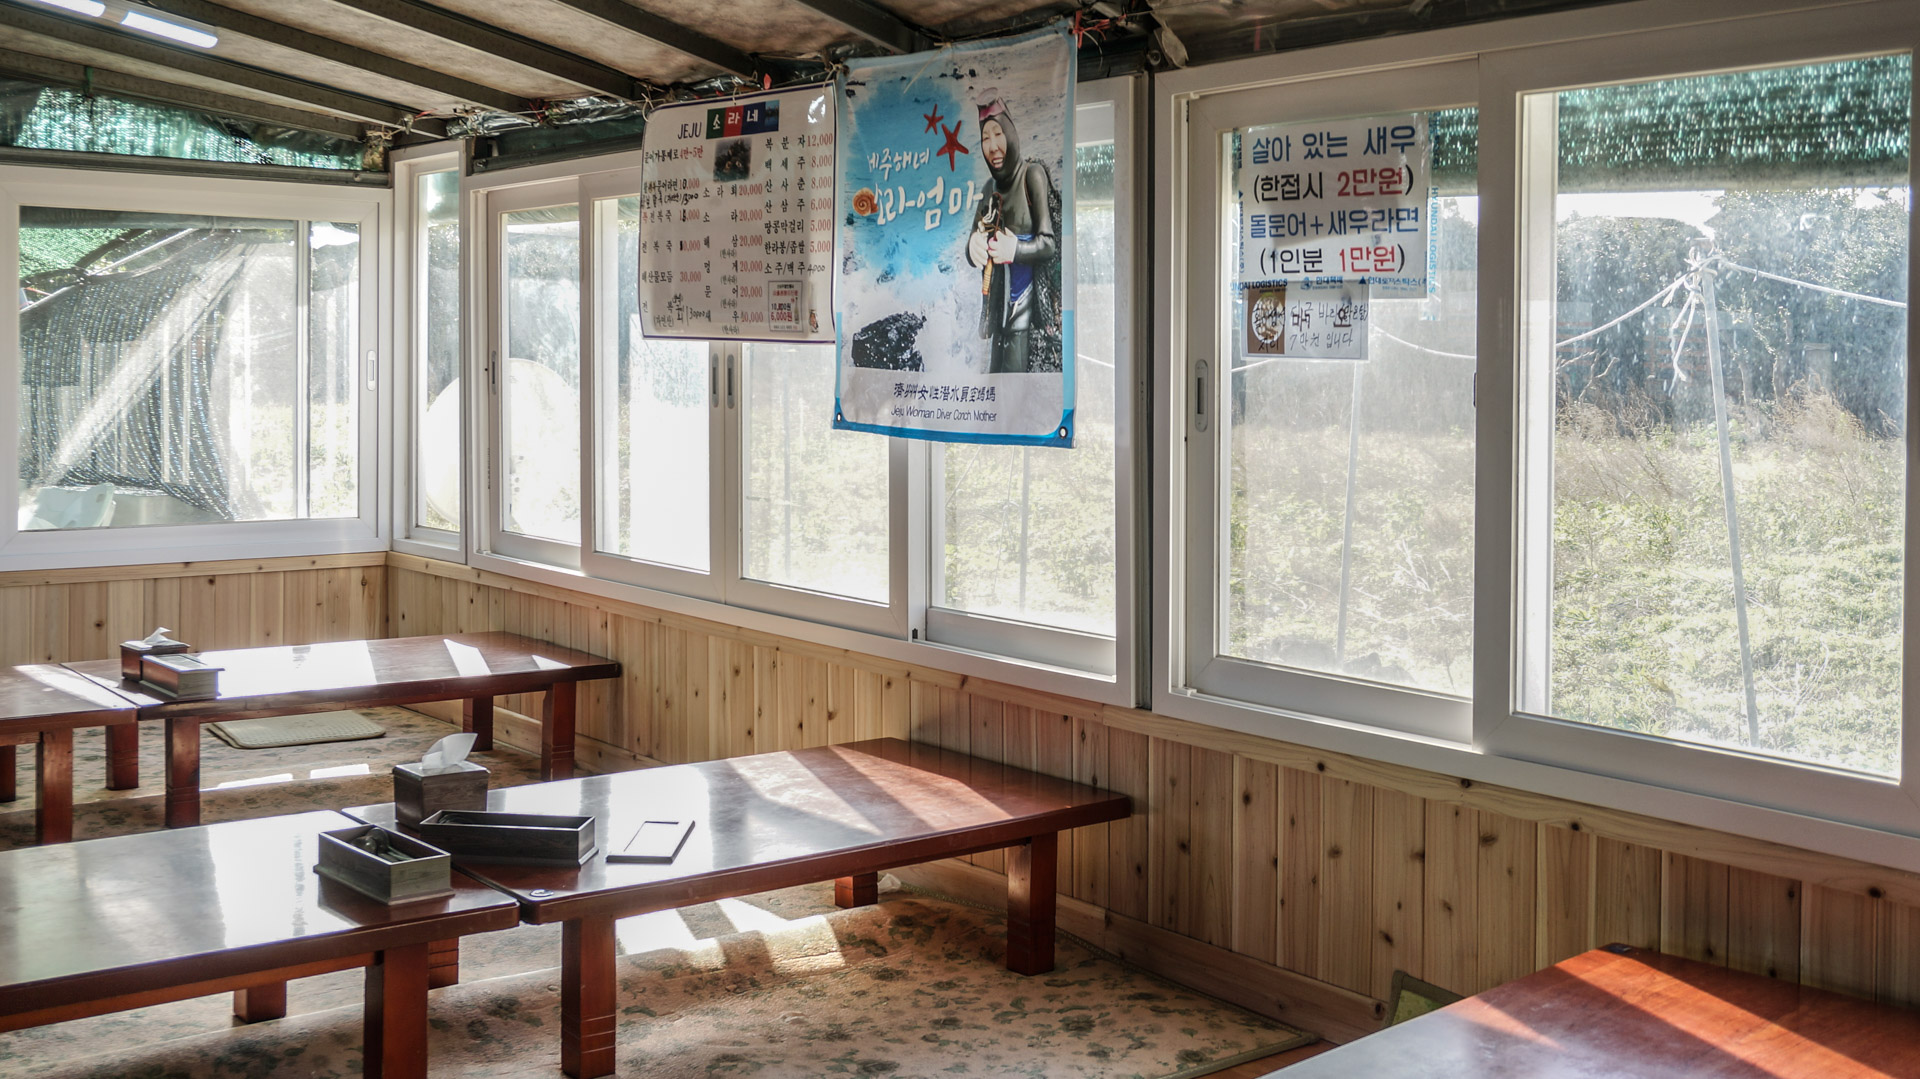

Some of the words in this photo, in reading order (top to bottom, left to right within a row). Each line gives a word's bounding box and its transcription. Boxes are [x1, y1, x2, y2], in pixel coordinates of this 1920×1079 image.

[678, 122, 702, 139] JEJU
[807, 133, 833, 147] 12,000
[1252, 135, 1291, 165] 살아
[1302, 131, 1348, 160] 있는
[1363, 125, 1416, 156] 새우
[811, 154, 832, 168] 8,000
[811, 176, 832, 189] 8,000
[1253, 171, 1323, 204] (한접시
[1337, 164, 1414, 197] 2만원)
[739, 183, 763, 196] 20,000
[810, 198, 832, 210] 6,000
[739, 209, 763, 221] 20,000
[1430, 187, 1440, 236] HYUNDAI
[764, 219, 804, 234] 땅콩막걸리
[810, 219, 831, 232] 5,000
[739, 235, 763, 247] 20,000
[809, 241, 831, 253] 5,000
[740, 260, 763, 272] 20,000
[1260, 247, 1323, 276] (1인분
[1339, 243, 1405, 273] 1만원)
[680, 271, 701, 283] 30,000
[1252, 278, 1288, 289] LOGISTICS
[740, 286, 763, 298] 20,000
[891, 405, 905, 417] Jeju
[906, 405, 934, 419] Woman
[936, 408, 953, 420] Diver
[973, 410, 997, 422] Mother
